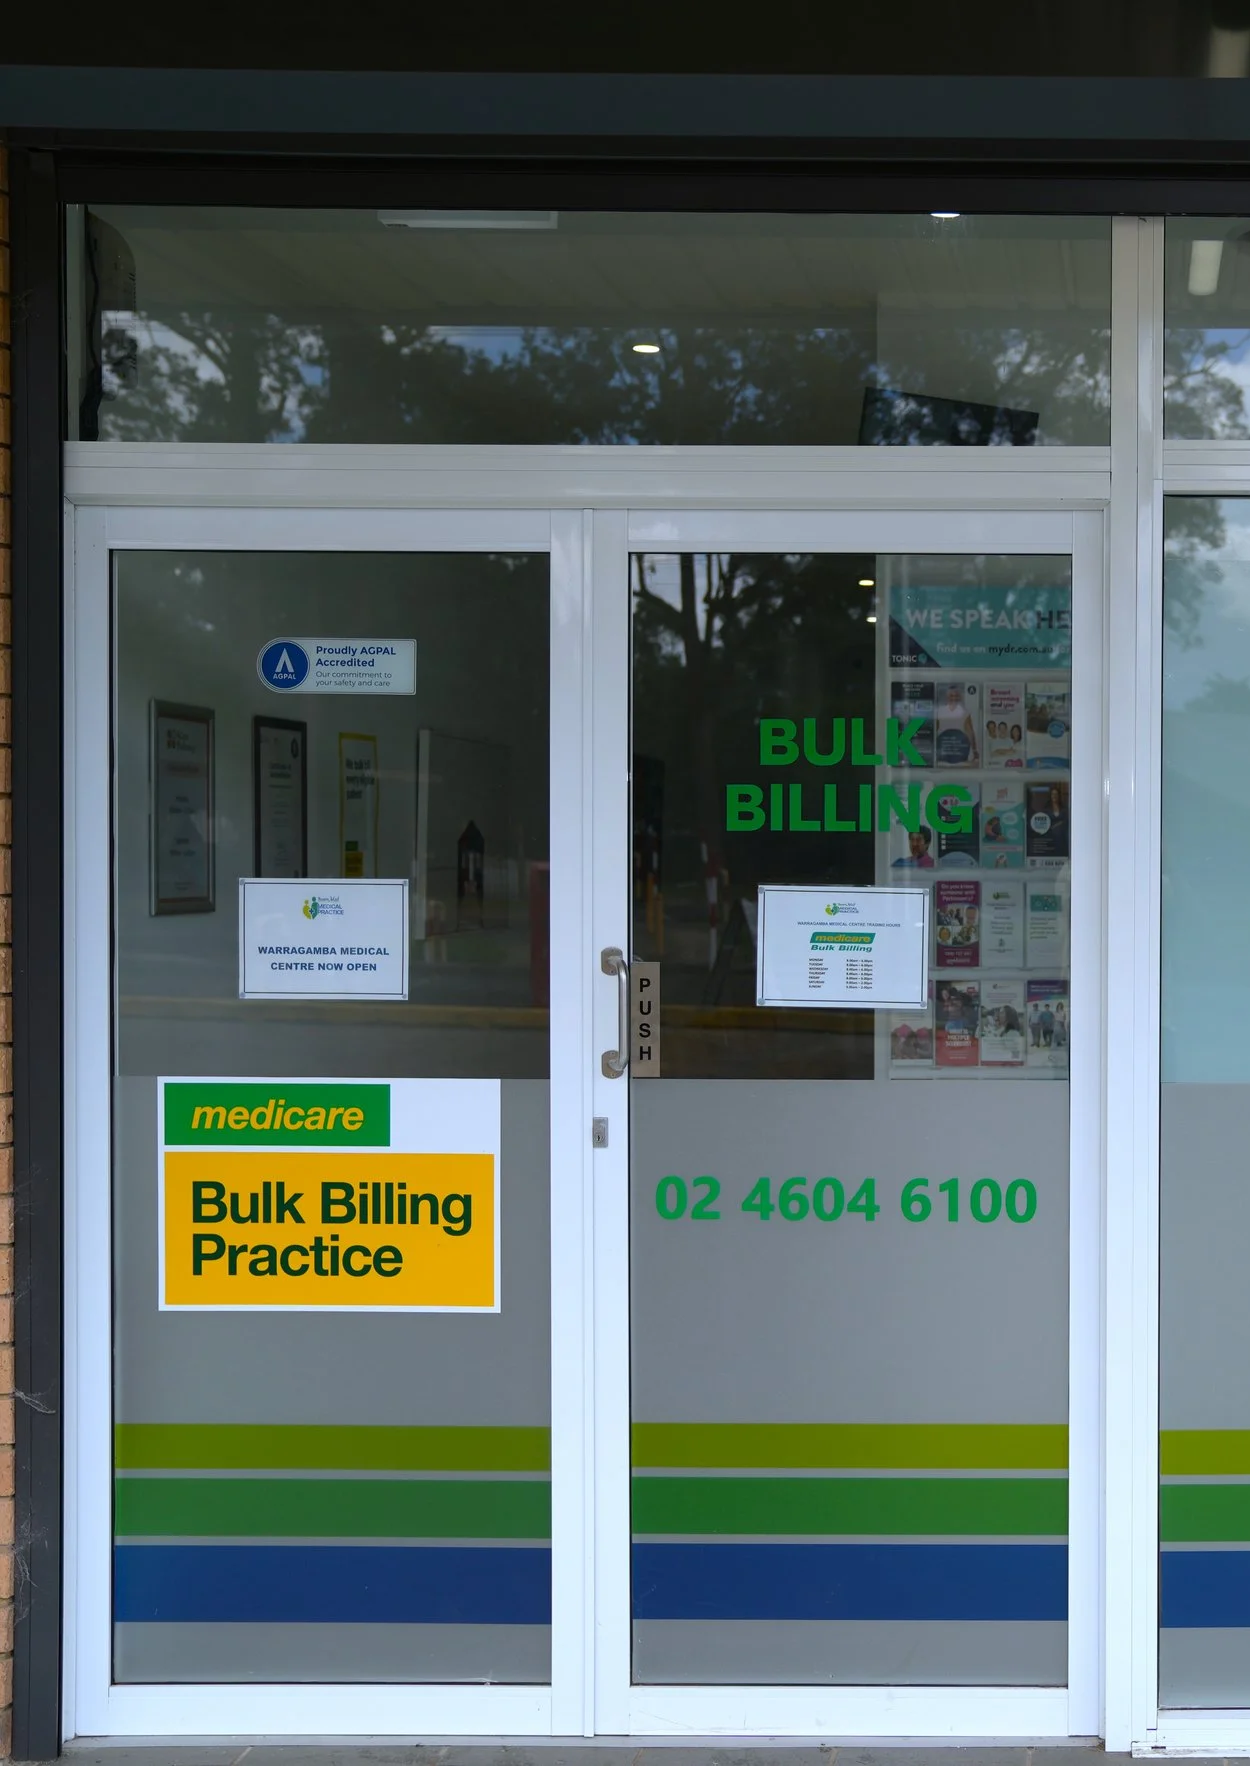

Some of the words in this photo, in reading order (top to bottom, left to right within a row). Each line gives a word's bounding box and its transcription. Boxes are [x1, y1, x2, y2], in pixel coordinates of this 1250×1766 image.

[906, 609, 944, 629] WE
[950, 609, 1029, 629] SPEAK
[315, 646, 357, 656] Proudly
[360, 646, 396, 655] AGPAL
[936, 642, 957, 653] find
[315, 658, 375, 667] Accredited
[892, 655, 917, 663] TONIC
[332, 671, 383, 679] commitment
[334, 679, 356, 687] safety
[759, 717, 926, 768] BULK
[726, 783, 974, 834] BILLING
[815, 934, 871, 943] medicare
[258, 946, 337, 955] WARRAGAMBA
[340, 947, 389, 956] MEDICAL
[838, 945, 873, 953] Billing
[270, 962, 314, 970] CENTRE
[317, 963, 343, 971] NOW
[346, 963, 377, 971] OPEN
[638, 977, 652, 1061] PUSH
[190, 1099, 364, 1132] medicare
[656, 1177, 720, 1223] 02
[742, 1177, 878, 1223] 4604
[901, 1177, 1037, 1222] 6100
[192, 1180, 306, 1225] Bulk
[320, 1181, 473, 1237] Billing
[192, 1233, 404, 1278] Practice
